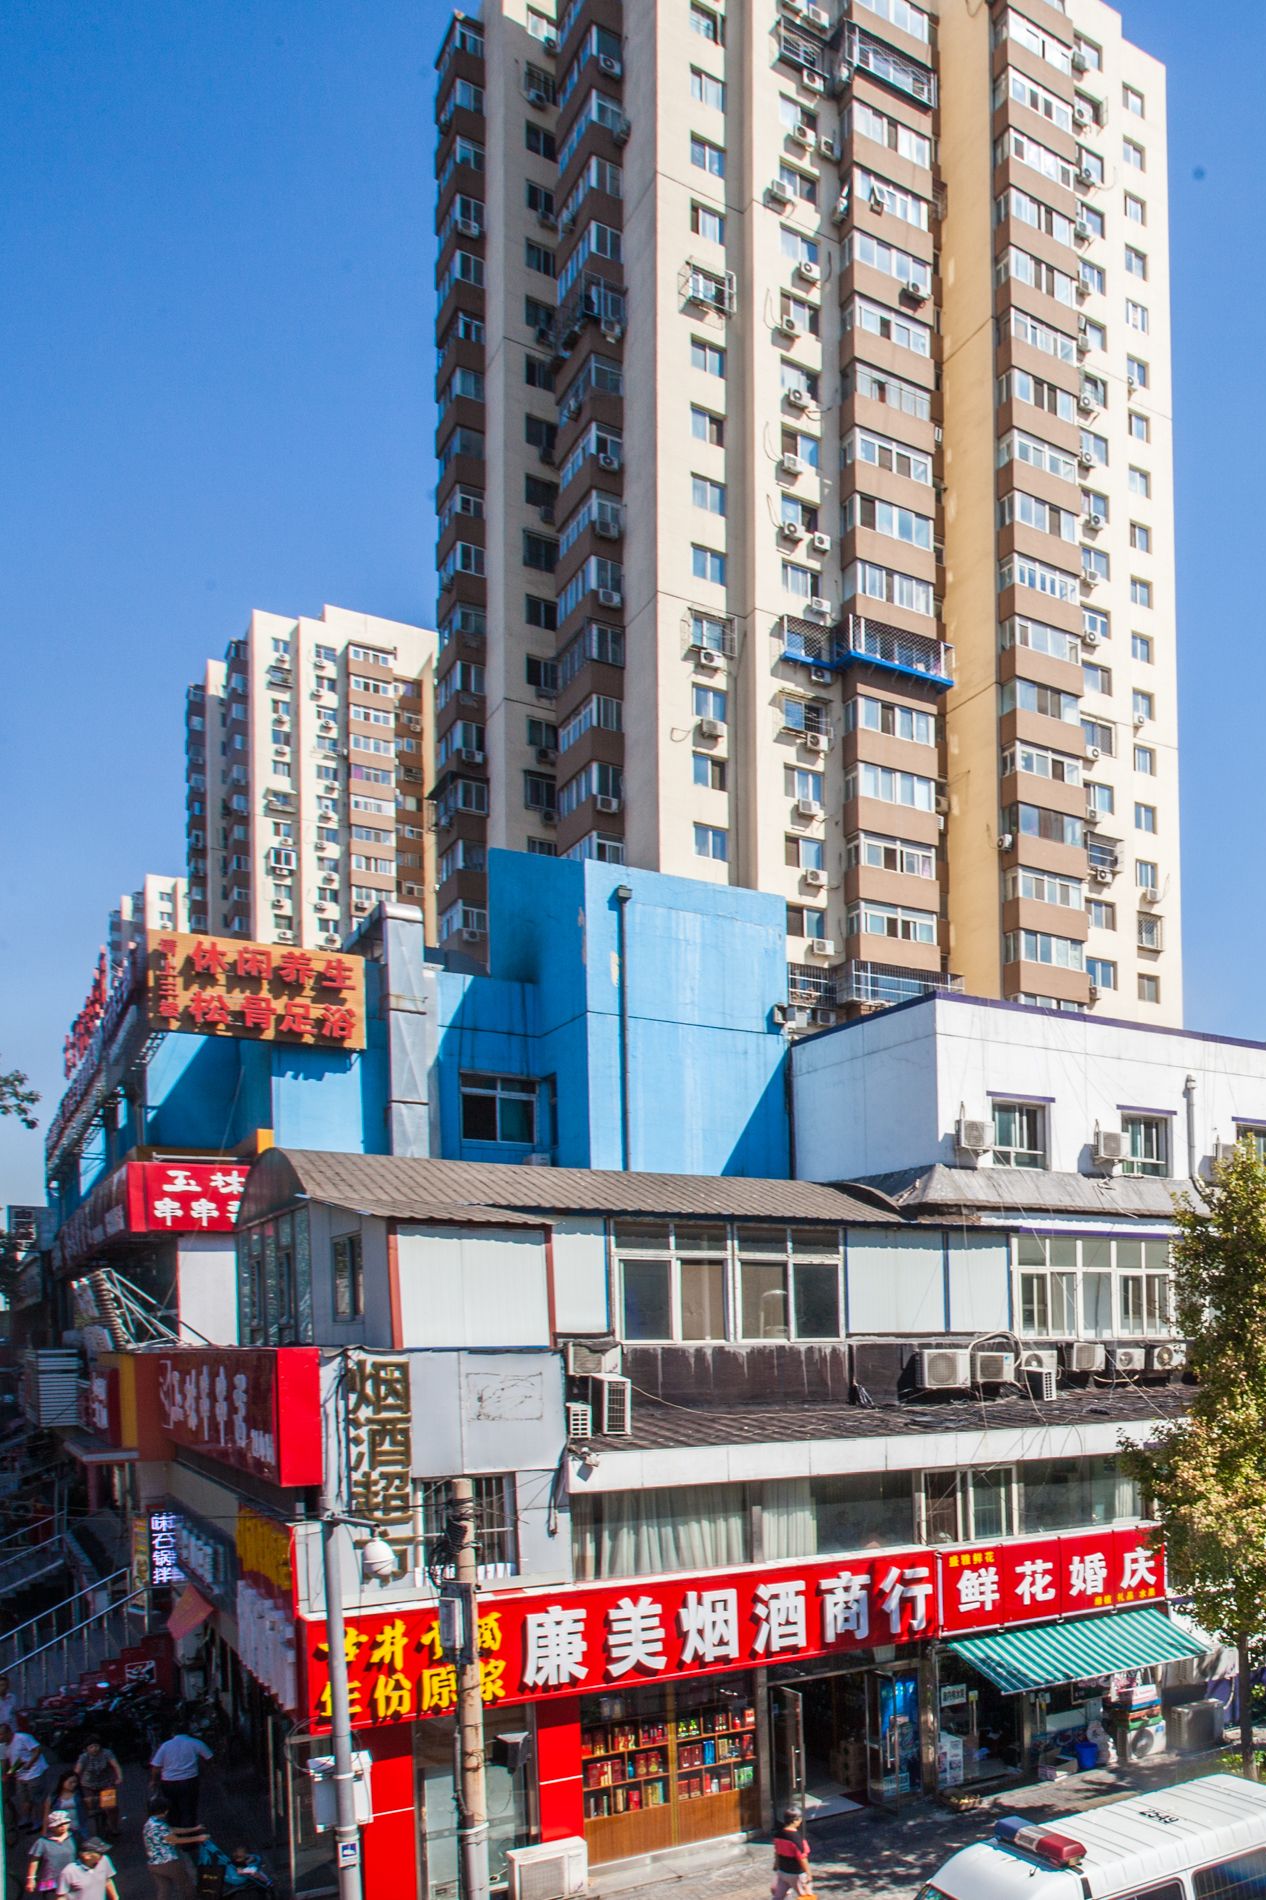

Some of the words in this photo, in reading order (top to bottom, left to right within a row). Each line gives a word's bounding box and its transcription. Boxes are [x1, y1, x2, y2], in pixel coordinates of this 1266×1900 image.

[191, 940, 357, 991] 休闲养生
[188, 988, 357, 1039] 松骨足浴
[162, 1169, 247, 1194] 玉林
[348, 1357, 415, 1589] 烟酒超市
[956, 1546, 1158, 1614] 鲜花婚庆
[523, 1565, 934, 1688] 廉美烟酒商行
